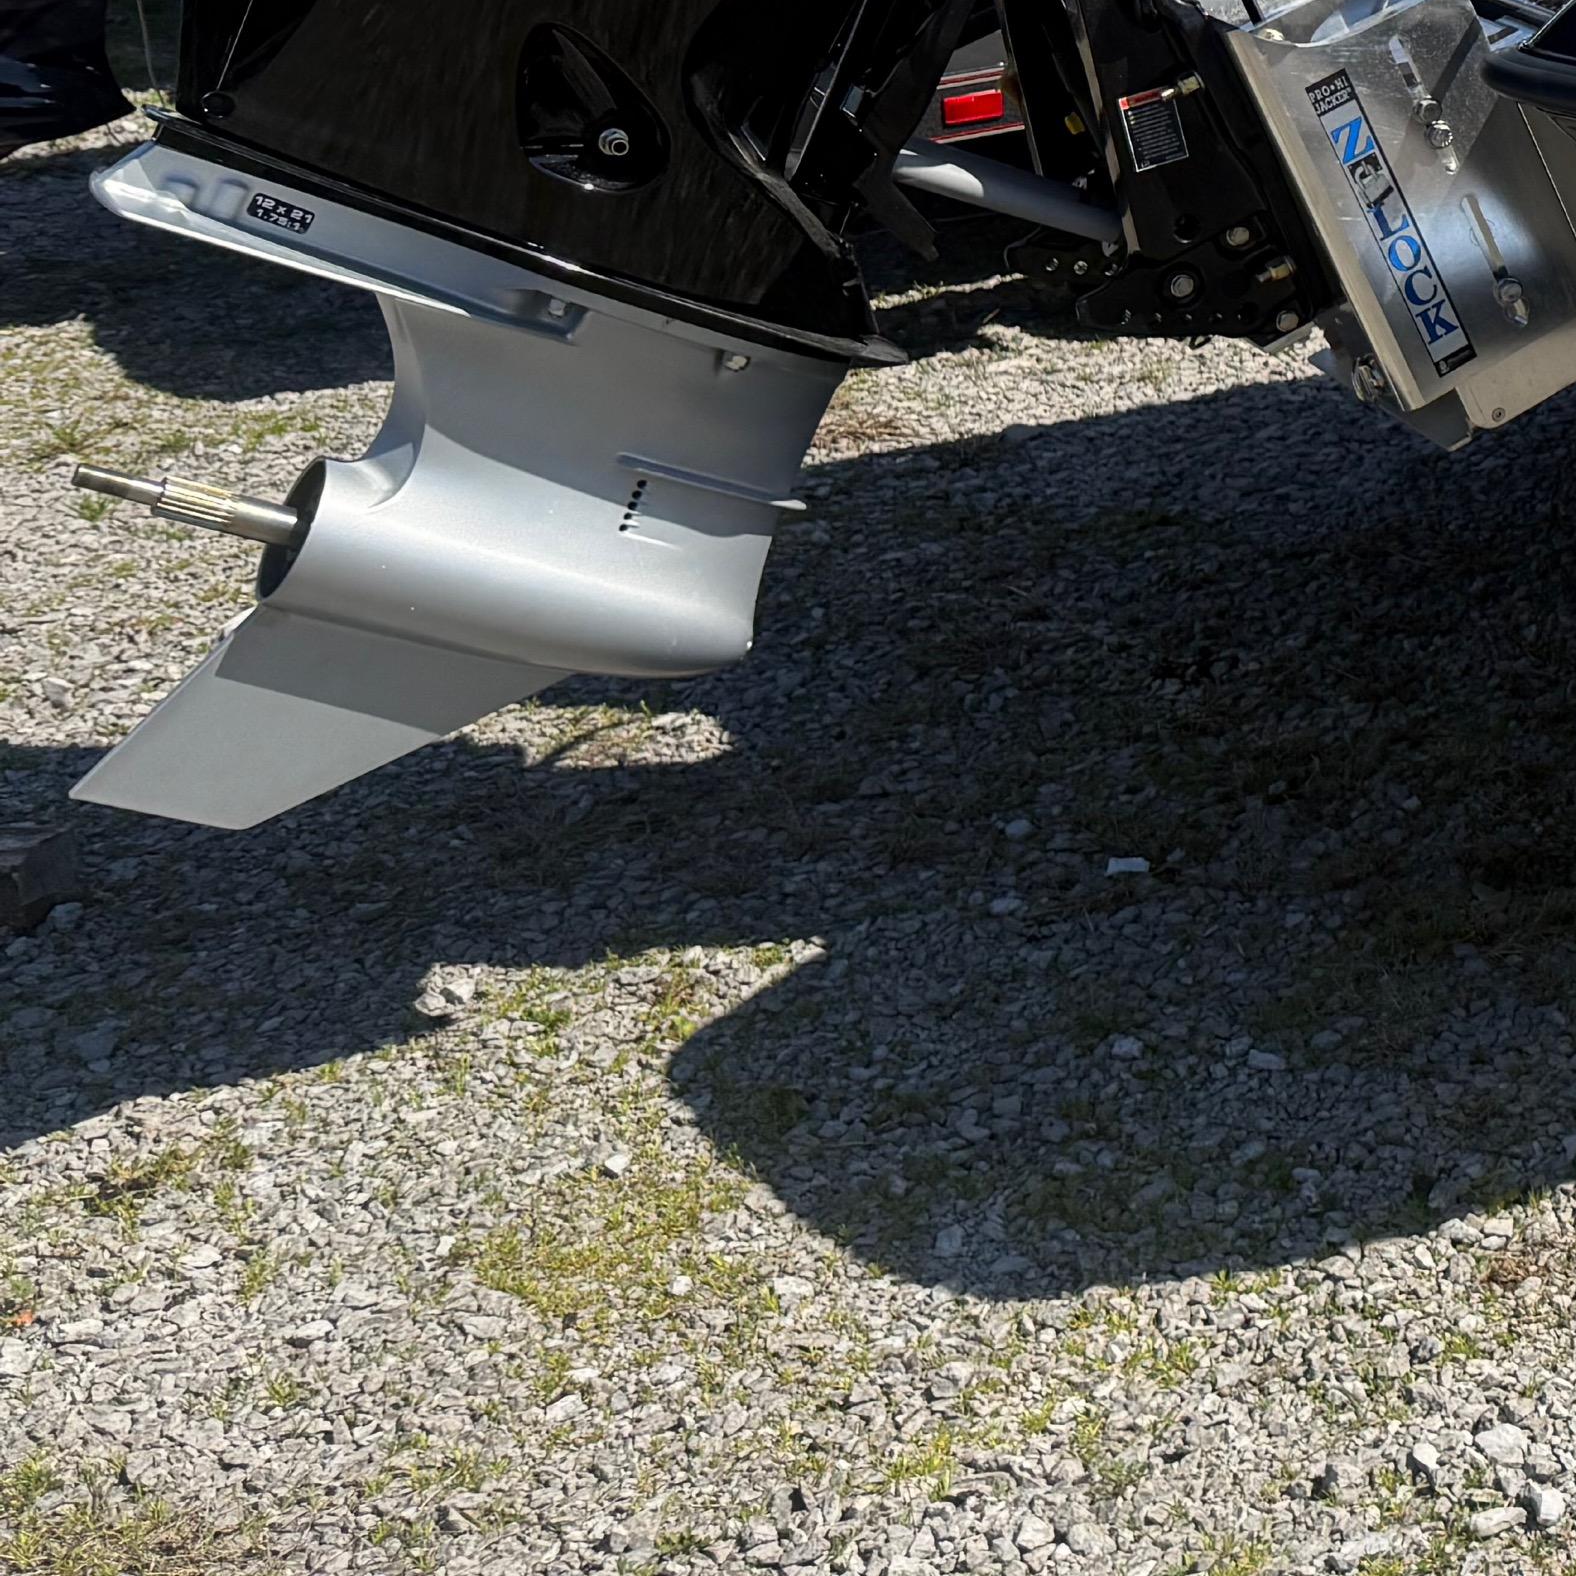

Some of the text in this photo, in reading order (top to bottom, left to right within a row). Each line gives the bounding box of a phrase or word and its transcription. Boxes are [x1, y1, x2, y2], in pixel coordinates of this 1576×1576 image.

[255, 195, 313, 223] 12 x 21
[256, 208, 301, 231] 1.75:1
[1366, 203, 1460, 345] LOCK
